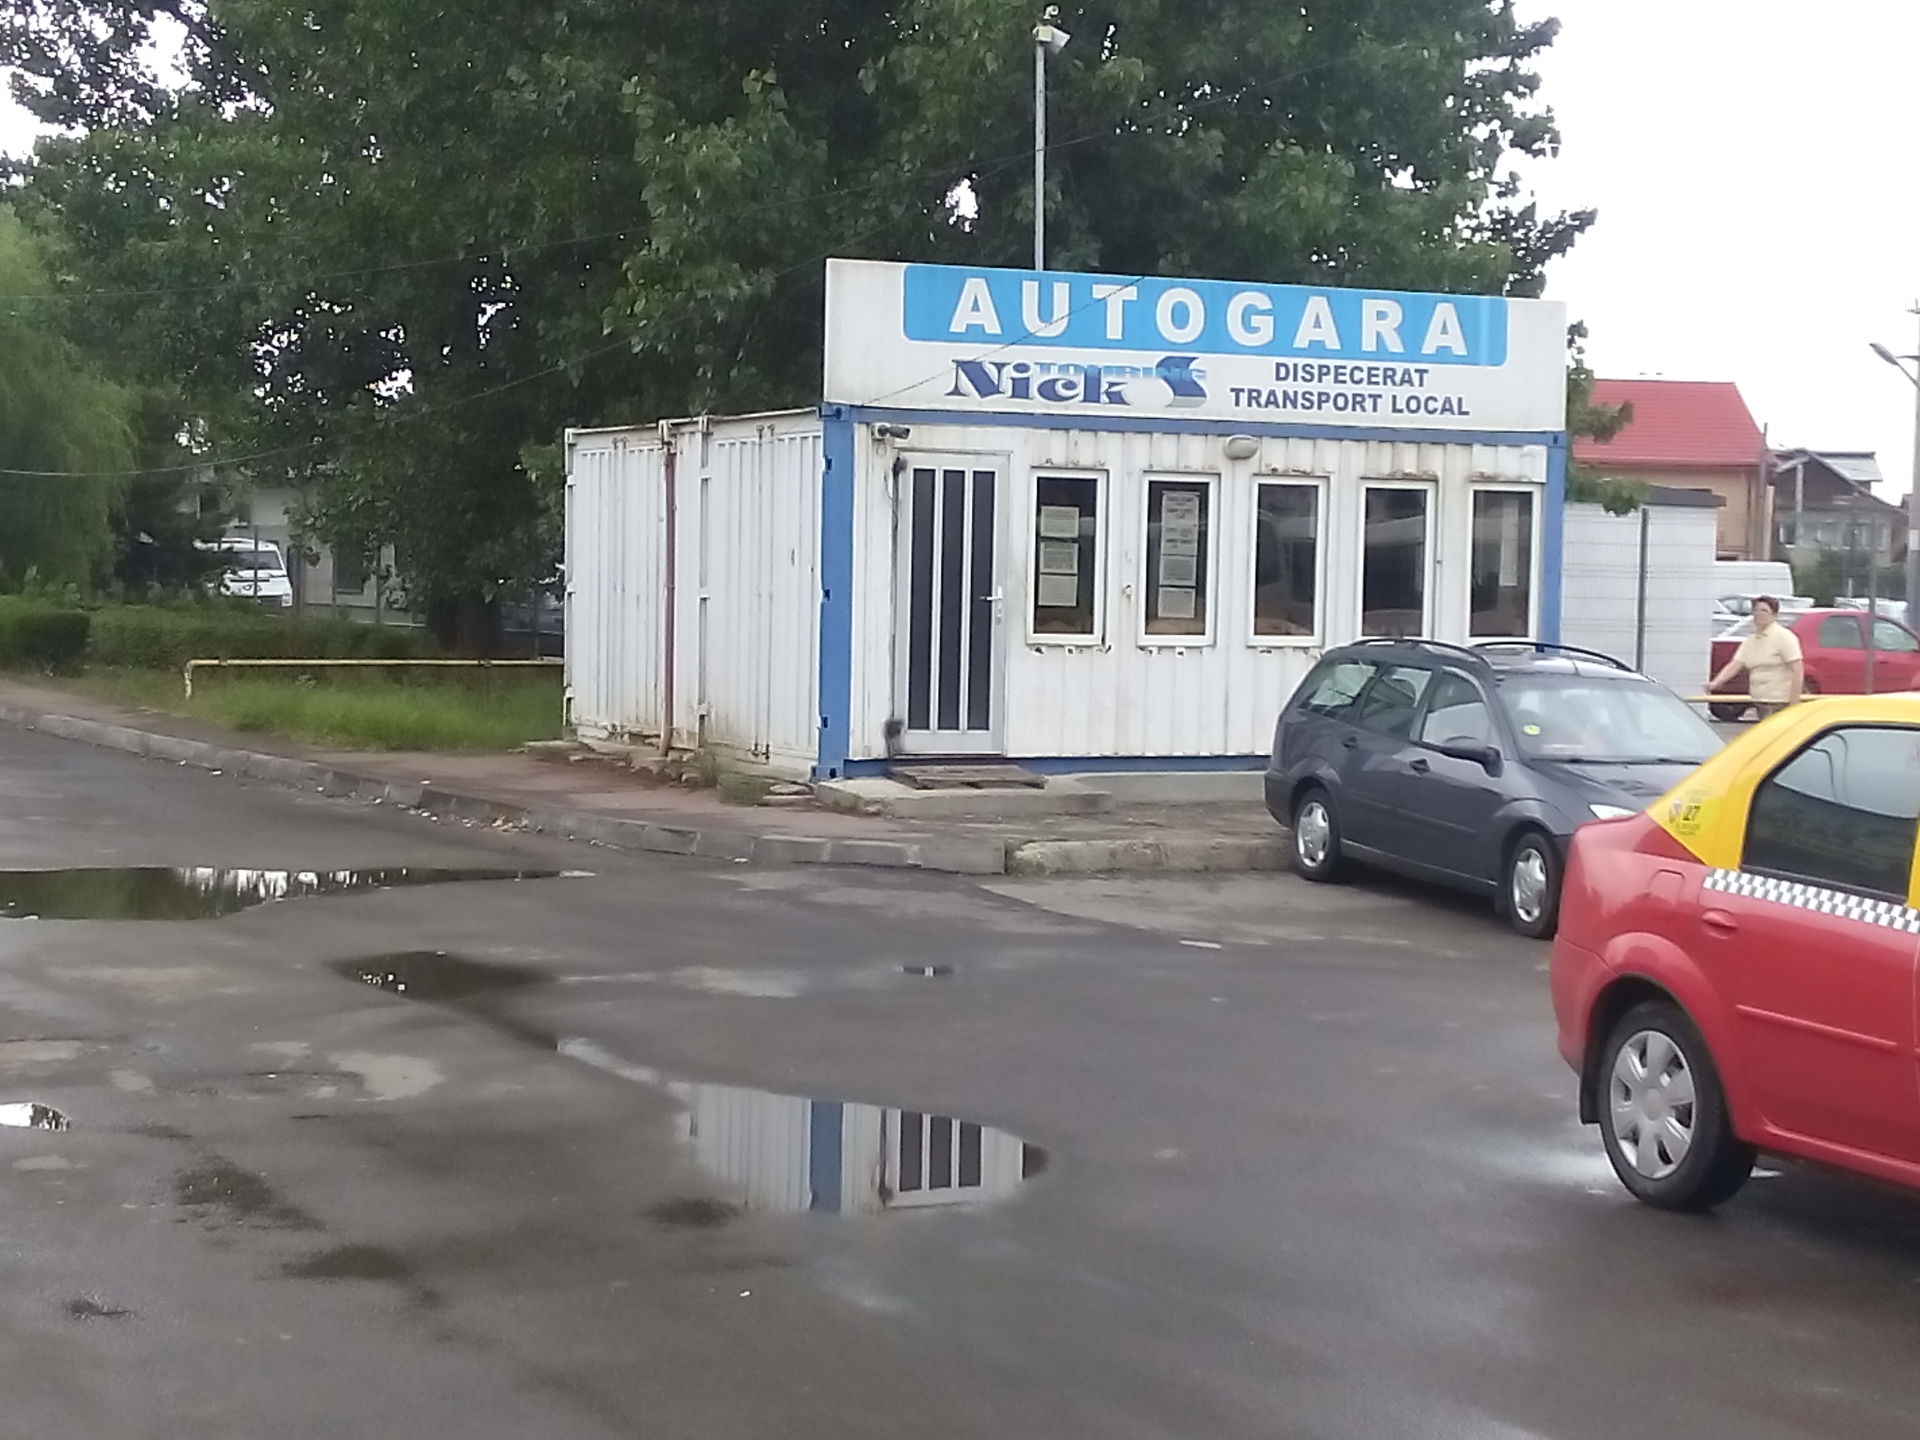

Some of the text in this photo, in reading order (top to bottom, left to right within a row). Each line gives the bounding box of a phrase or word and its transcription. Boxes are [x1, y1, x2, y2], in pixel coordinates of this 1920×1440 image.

[949, 277, 1470, 357] AUTOGARA
[945, 359, 1131, 406] Nick
[1274, 361, 1429, 388] DISPECERAT
[1230, 386, 1471, 417] TRANSPORT LOCAL
